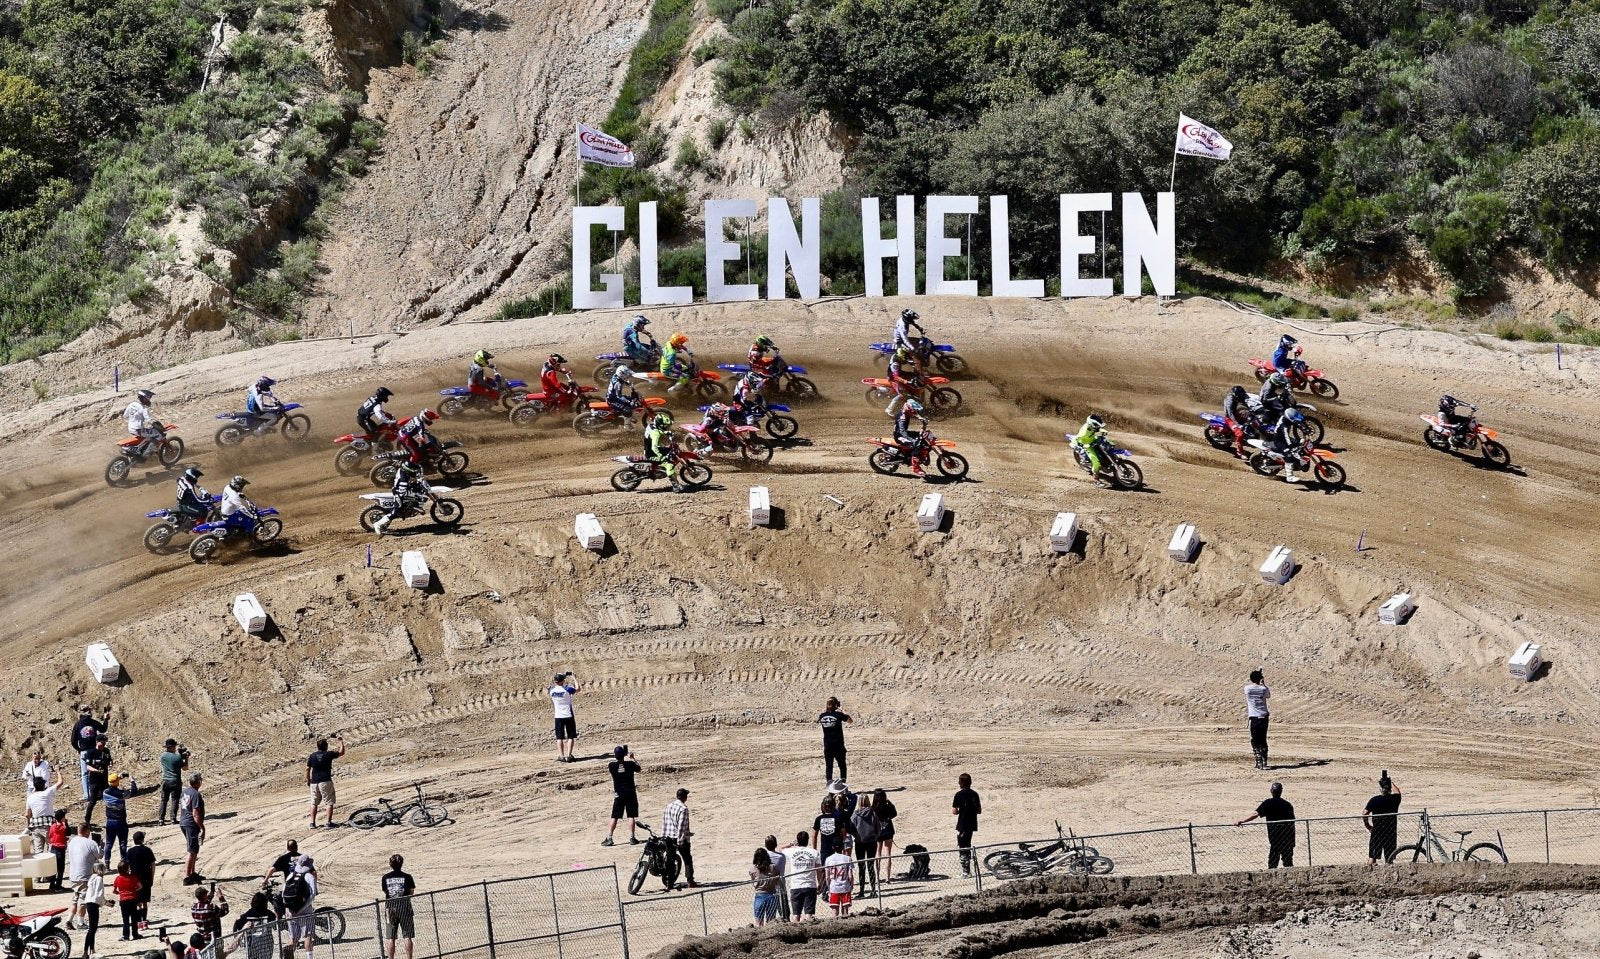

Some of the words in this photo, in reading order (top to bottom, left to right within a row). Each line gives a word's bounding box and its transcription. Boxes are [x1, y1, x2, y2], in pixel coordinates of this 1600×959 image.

[572, 197, 821, 309] GLEN
[861, 191, 1176, 298] HELEN
[32, 919, 37, 930] 1
